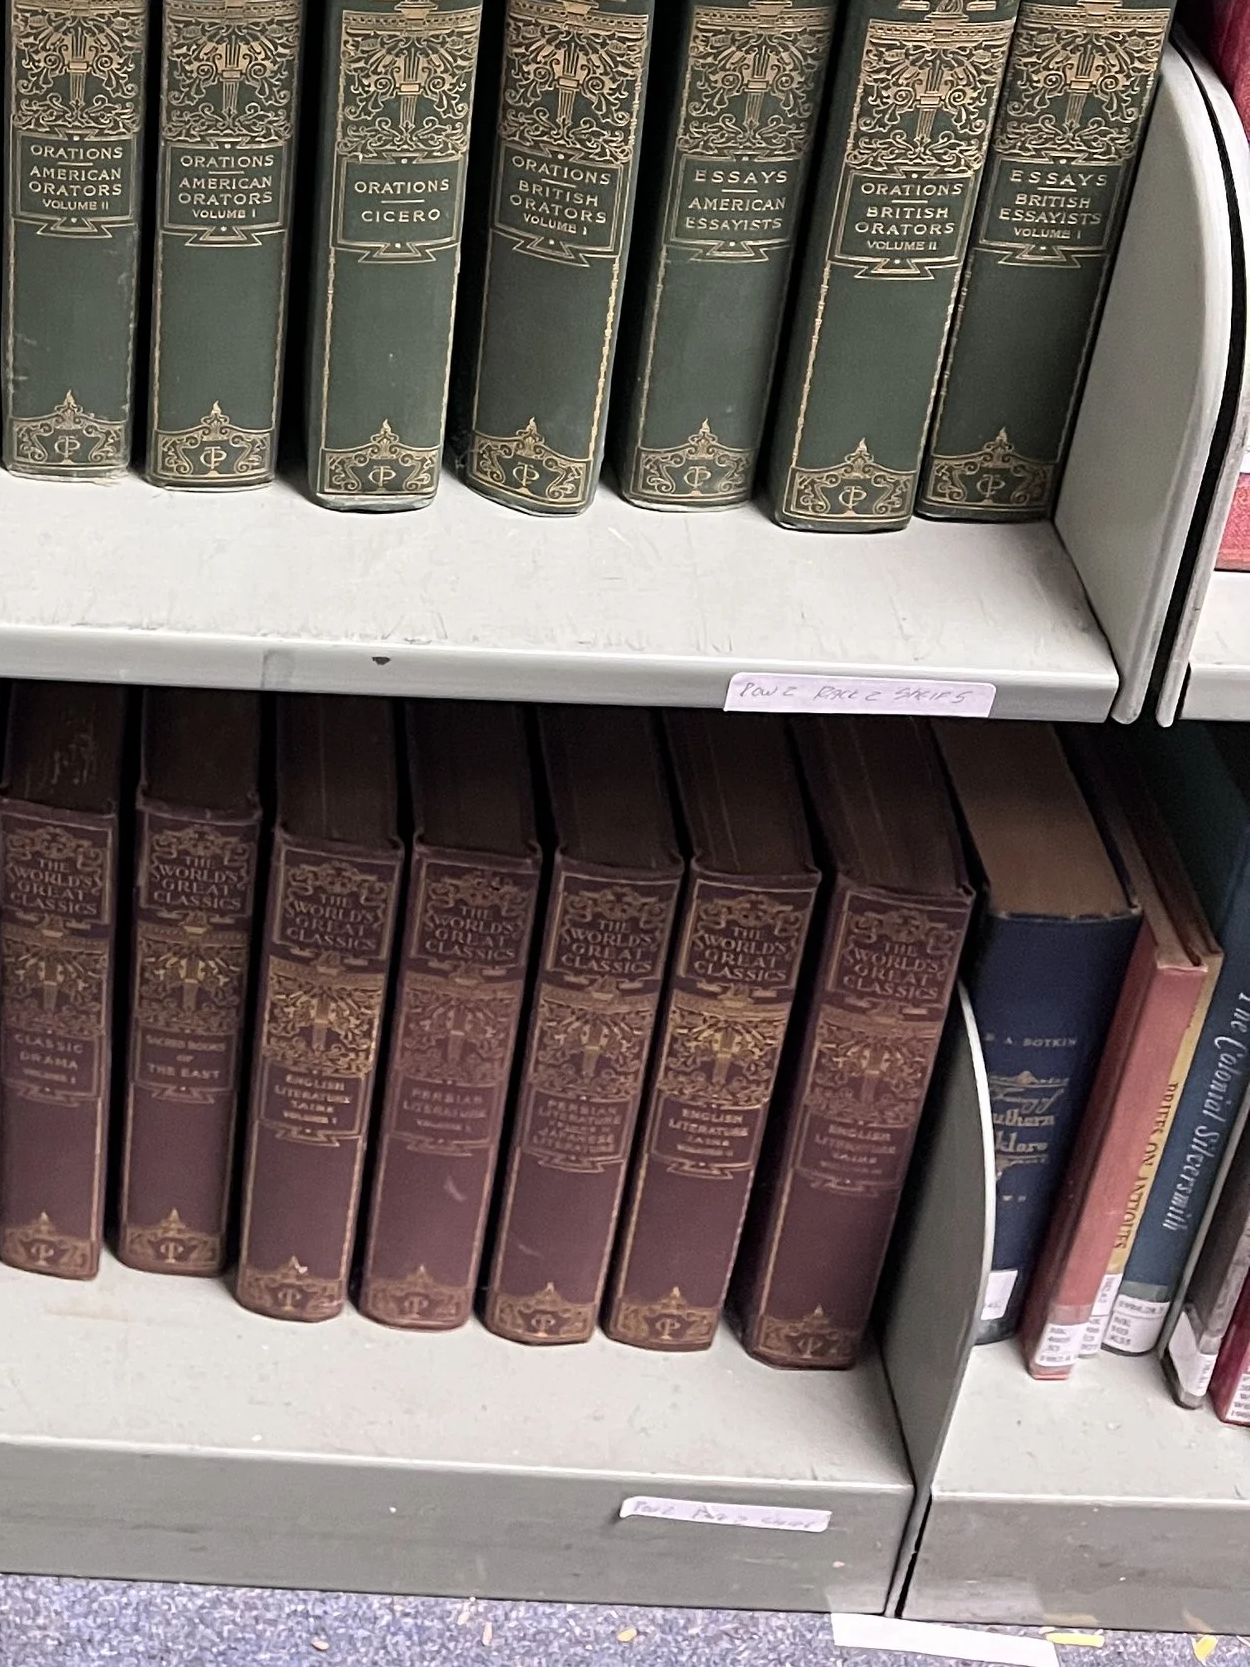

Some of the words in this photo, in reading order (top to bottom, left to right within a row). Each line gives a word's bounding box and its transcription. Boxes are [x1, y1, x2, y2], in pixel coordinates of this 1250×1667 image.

[30, 144, 123, 160] ORATIONS
[180, 154, 274, 168] ORATIONS
[30, 166, 121, 180] AMERICAN
[512, 156, 611, 185] ORATIONS
[695, 169, 788, 185] ESSAYS
[179, 176, 272, 189] AMERICAN
[1009, 170, 1108, 187] ESSAYS
[28, 182, 122, 196] ORATORS
[354, 179, 450, 194] ORATIONS
[518, 181, 599, 207] BRITISH
[860, 182, 963, 197] ORATIONS
[42, 199, 98, 210] VOLUME
[102, 200, 109, 210] II
[178, 190, 273, 205] ORATORS
[688, 196, 786, 212] AMERICAN
[1015, 193, 1090, 208] BRITISH
[192, 209, 247, 219] VOLUME
[252, 209, 256, 218] I
[360, 208, 441, 223] CICERO
[510, 194, 606, 224] ORATORS
[866, 205, 949, 220] BRITISH
[998, 208, 1101, 225] ESSAYISTS
[523, 214, 576, 233] VOLUME
[582, 226, 587, 235] I
[686, 216, 783, 231] ESSAYISTS
[855, 221, 954, 235] ORATORS
[1013, 226, 1071, 239] VOLUME
[1077, 228, 1081, 238] I
[866, 239, 923, 251] VOLUME
[929, 240, 937, 251] II
